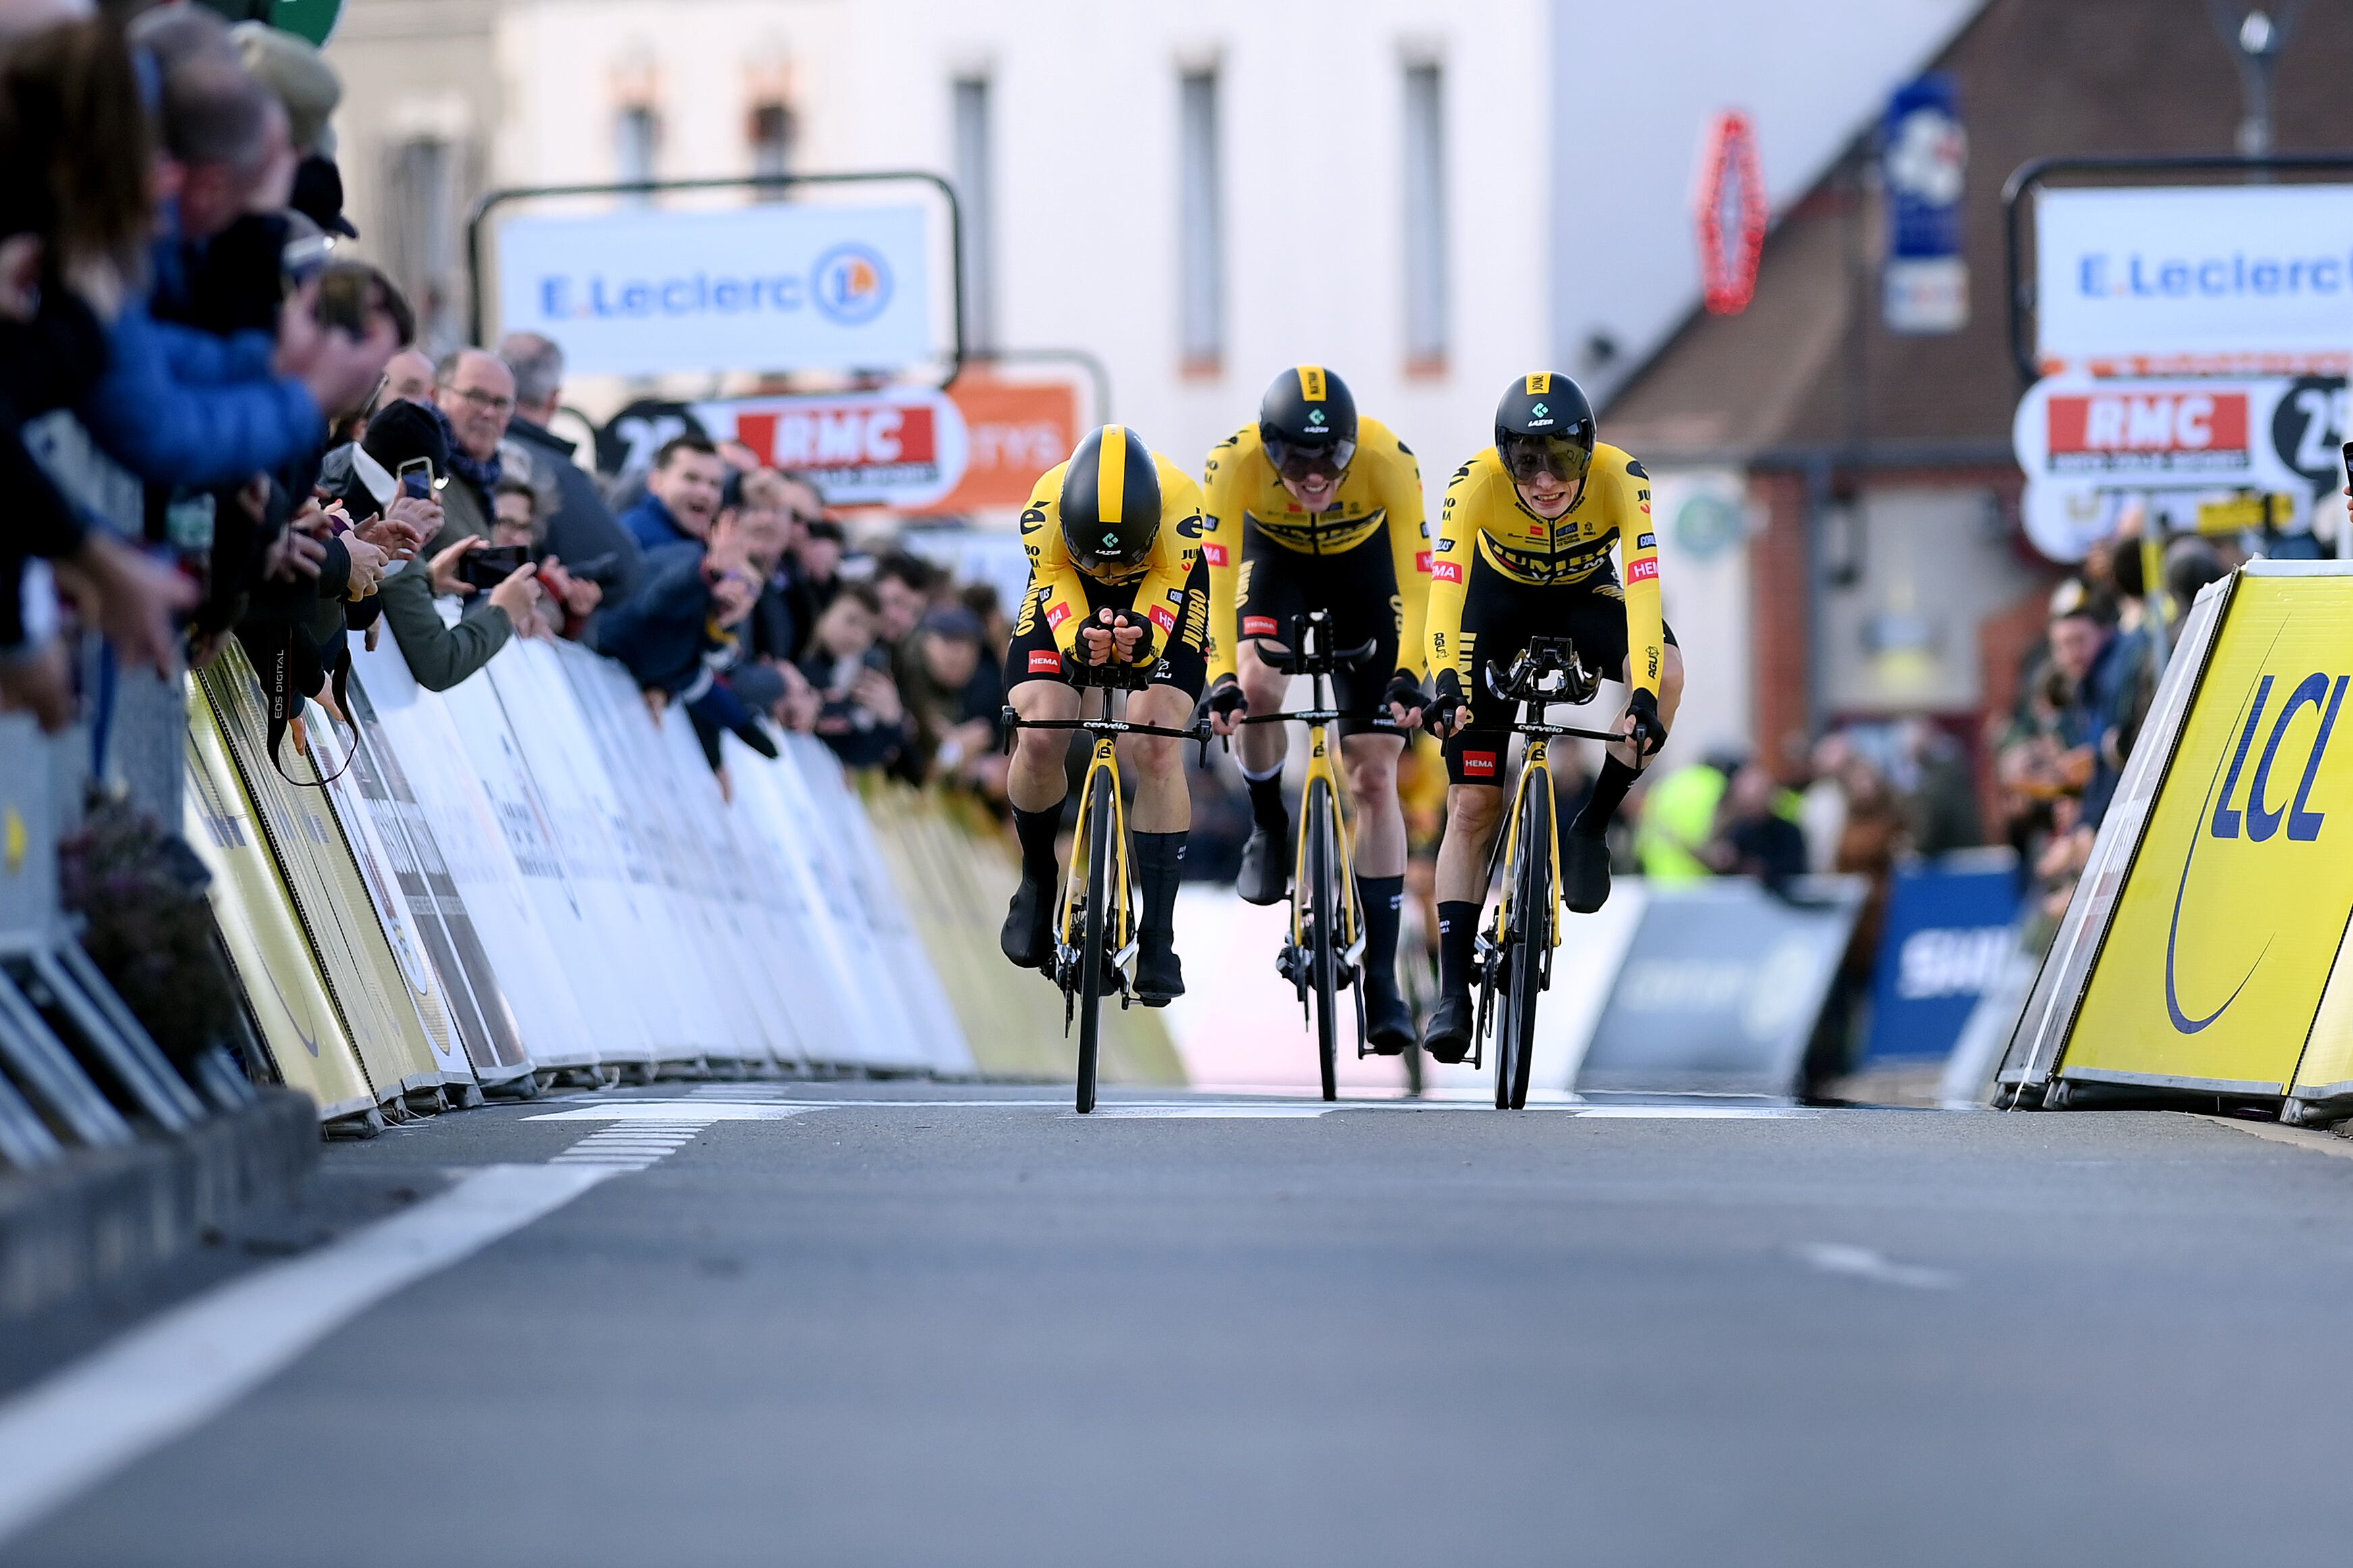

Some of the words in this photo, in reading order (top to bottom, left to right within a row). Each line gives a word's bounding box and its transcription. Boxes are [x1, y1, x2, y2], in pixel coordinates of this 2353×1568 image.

[2079, 250, 2341, 298] E.Leclerc
[540, 271, 808, 320] E.Leclerc
[1528, 419, 1554, 427] LAZER
[2086, 397, 2217, 448] RMC
[777, 411, 905, 465] RMC
[1182, 588, 1206, 653] JUMBO
[1433, 632, 1445, 653] AGU
[276, 649, 284, 693] DIGITAL
[1031, 658, 1058, 667] HEMA
[1647, 655, 1658, 679] AGU
[274, 696, 283, 719] EOS
[1083, 721, 1129, 731] cervélo
[1518, 724, 1563, 733] cervélo
[1465, 759, 1493, 768] HEMA
[2210, 672, 2351, 843] LCL
